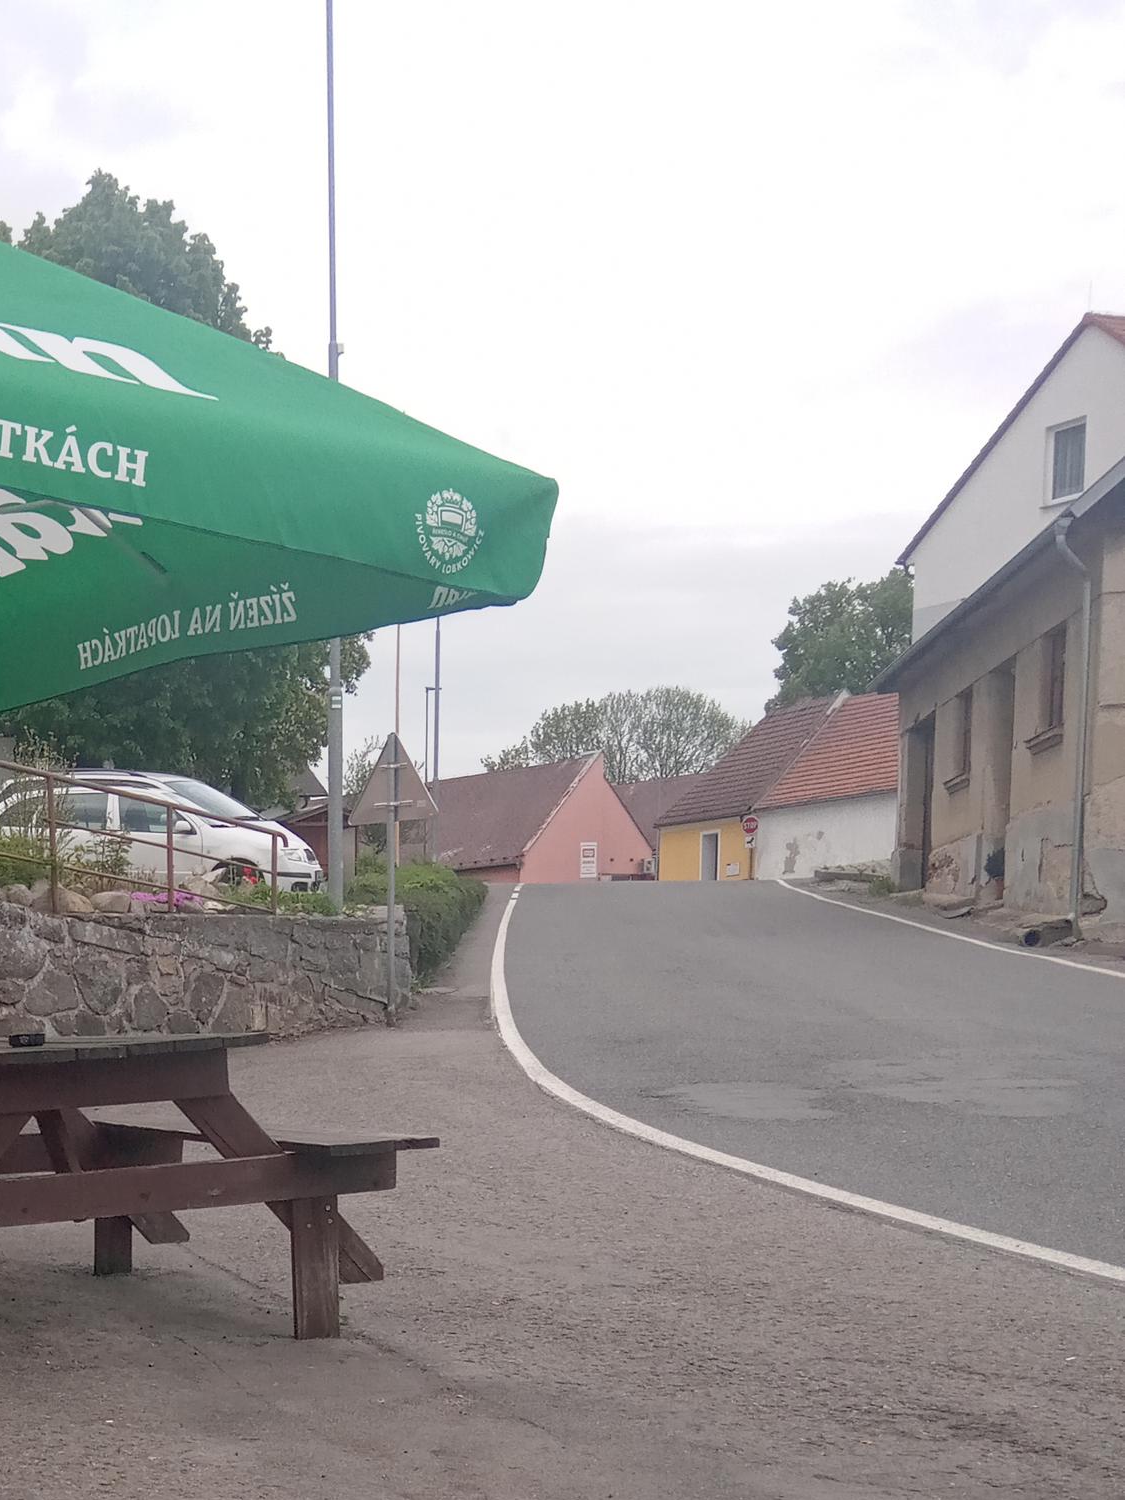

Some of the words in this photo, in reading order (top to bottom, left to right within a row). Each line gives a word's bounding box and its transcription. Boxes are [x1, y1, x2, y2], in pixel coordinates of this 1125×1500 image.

[414, 513, 442, 569] PIVOVARY
[441, 529, 485, 575] LOBKOWICZ
[743, 821, 757, 830] STOP
